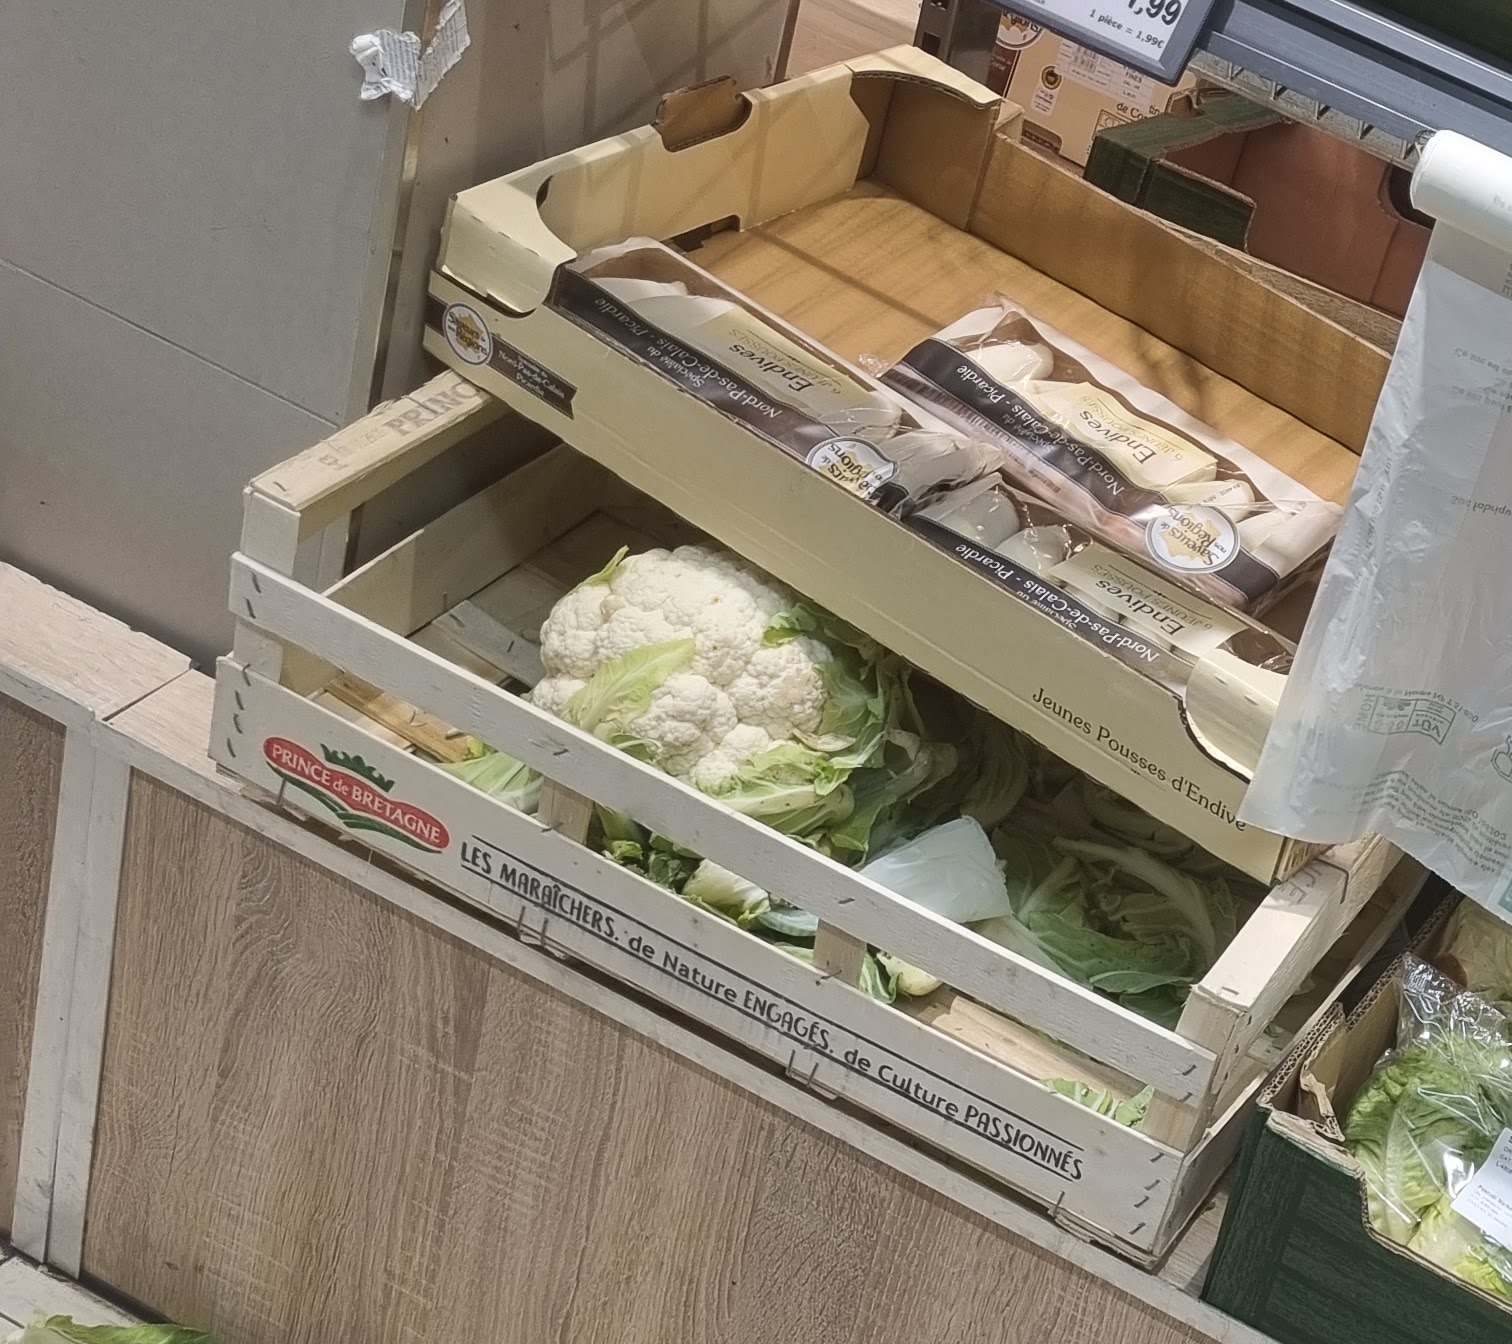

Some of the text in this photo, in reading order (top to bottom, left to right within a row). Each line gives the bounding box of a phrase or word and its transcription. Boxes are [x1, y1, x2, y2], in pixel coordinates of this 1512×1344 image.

[1089, 9, 1096, 18] 1
[1096, 12, 1124, 32] pièce
[590, 295, 786, 424] Nord-Pas-de-Calais Picardie
[726, 337, 814, 397] Endives
[954, 362, 1126, 497] Nord-Pas-de-Calais Picardie
[1075, 407, 1156, 468] Endives
[1166, 506, 1215, 549] Régions
[1168, 526, 1217, 568] Saveurs
[953, 540, 1162, 666] Nord-Pas-de-Calais Picardie
[1090, 561, 1153, 601] POUSSES
[1090, 576, 1187, 639] Endives
[1150, 595, 1204, 629] JEUNES
[1031, 686, 1249, 833] Jeunes Pousses d'Endive
[269, 743, 444, 844] PRINCE de BRETAGNE
[455, 840, 498, 874] LES
[624, 931, 658, 960] de
[660, 950, 740, 1004] Nature
[841, 1046, 873, 1072] de
[875, 1063, 961, 1118] Culture
[961, 1102, 1086, 1181] PASSIONNÉS
